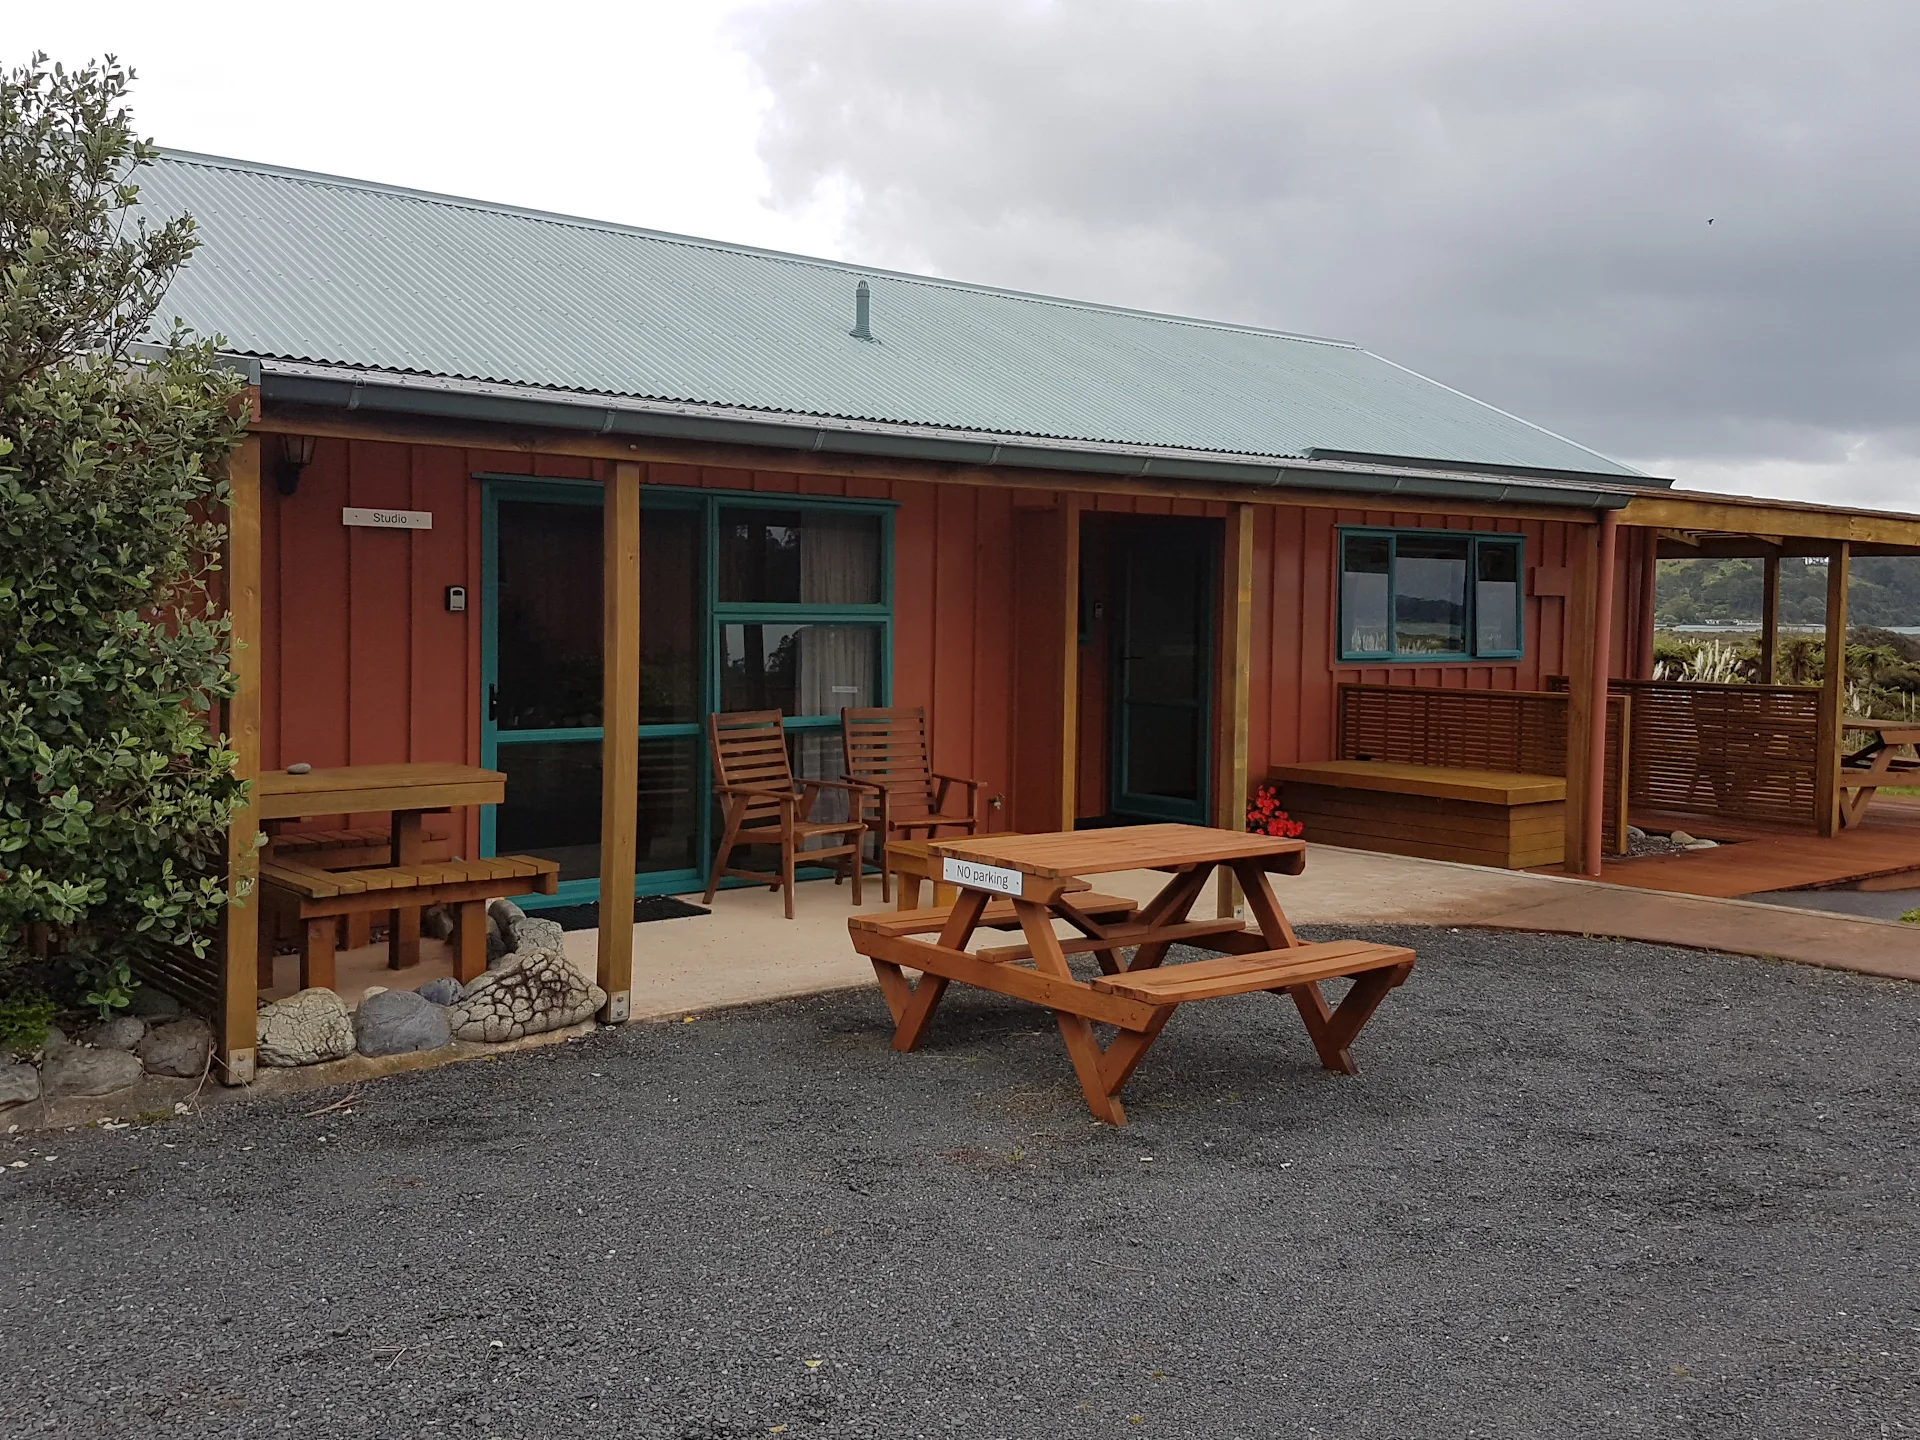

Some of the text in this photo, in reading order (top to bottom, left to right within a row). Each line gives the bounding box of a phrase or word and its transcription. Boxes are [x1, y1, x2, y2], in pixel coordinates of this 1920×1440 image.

[373, 513, 407, 524] Studio
[957, 865, 1009, 890] NO parking
